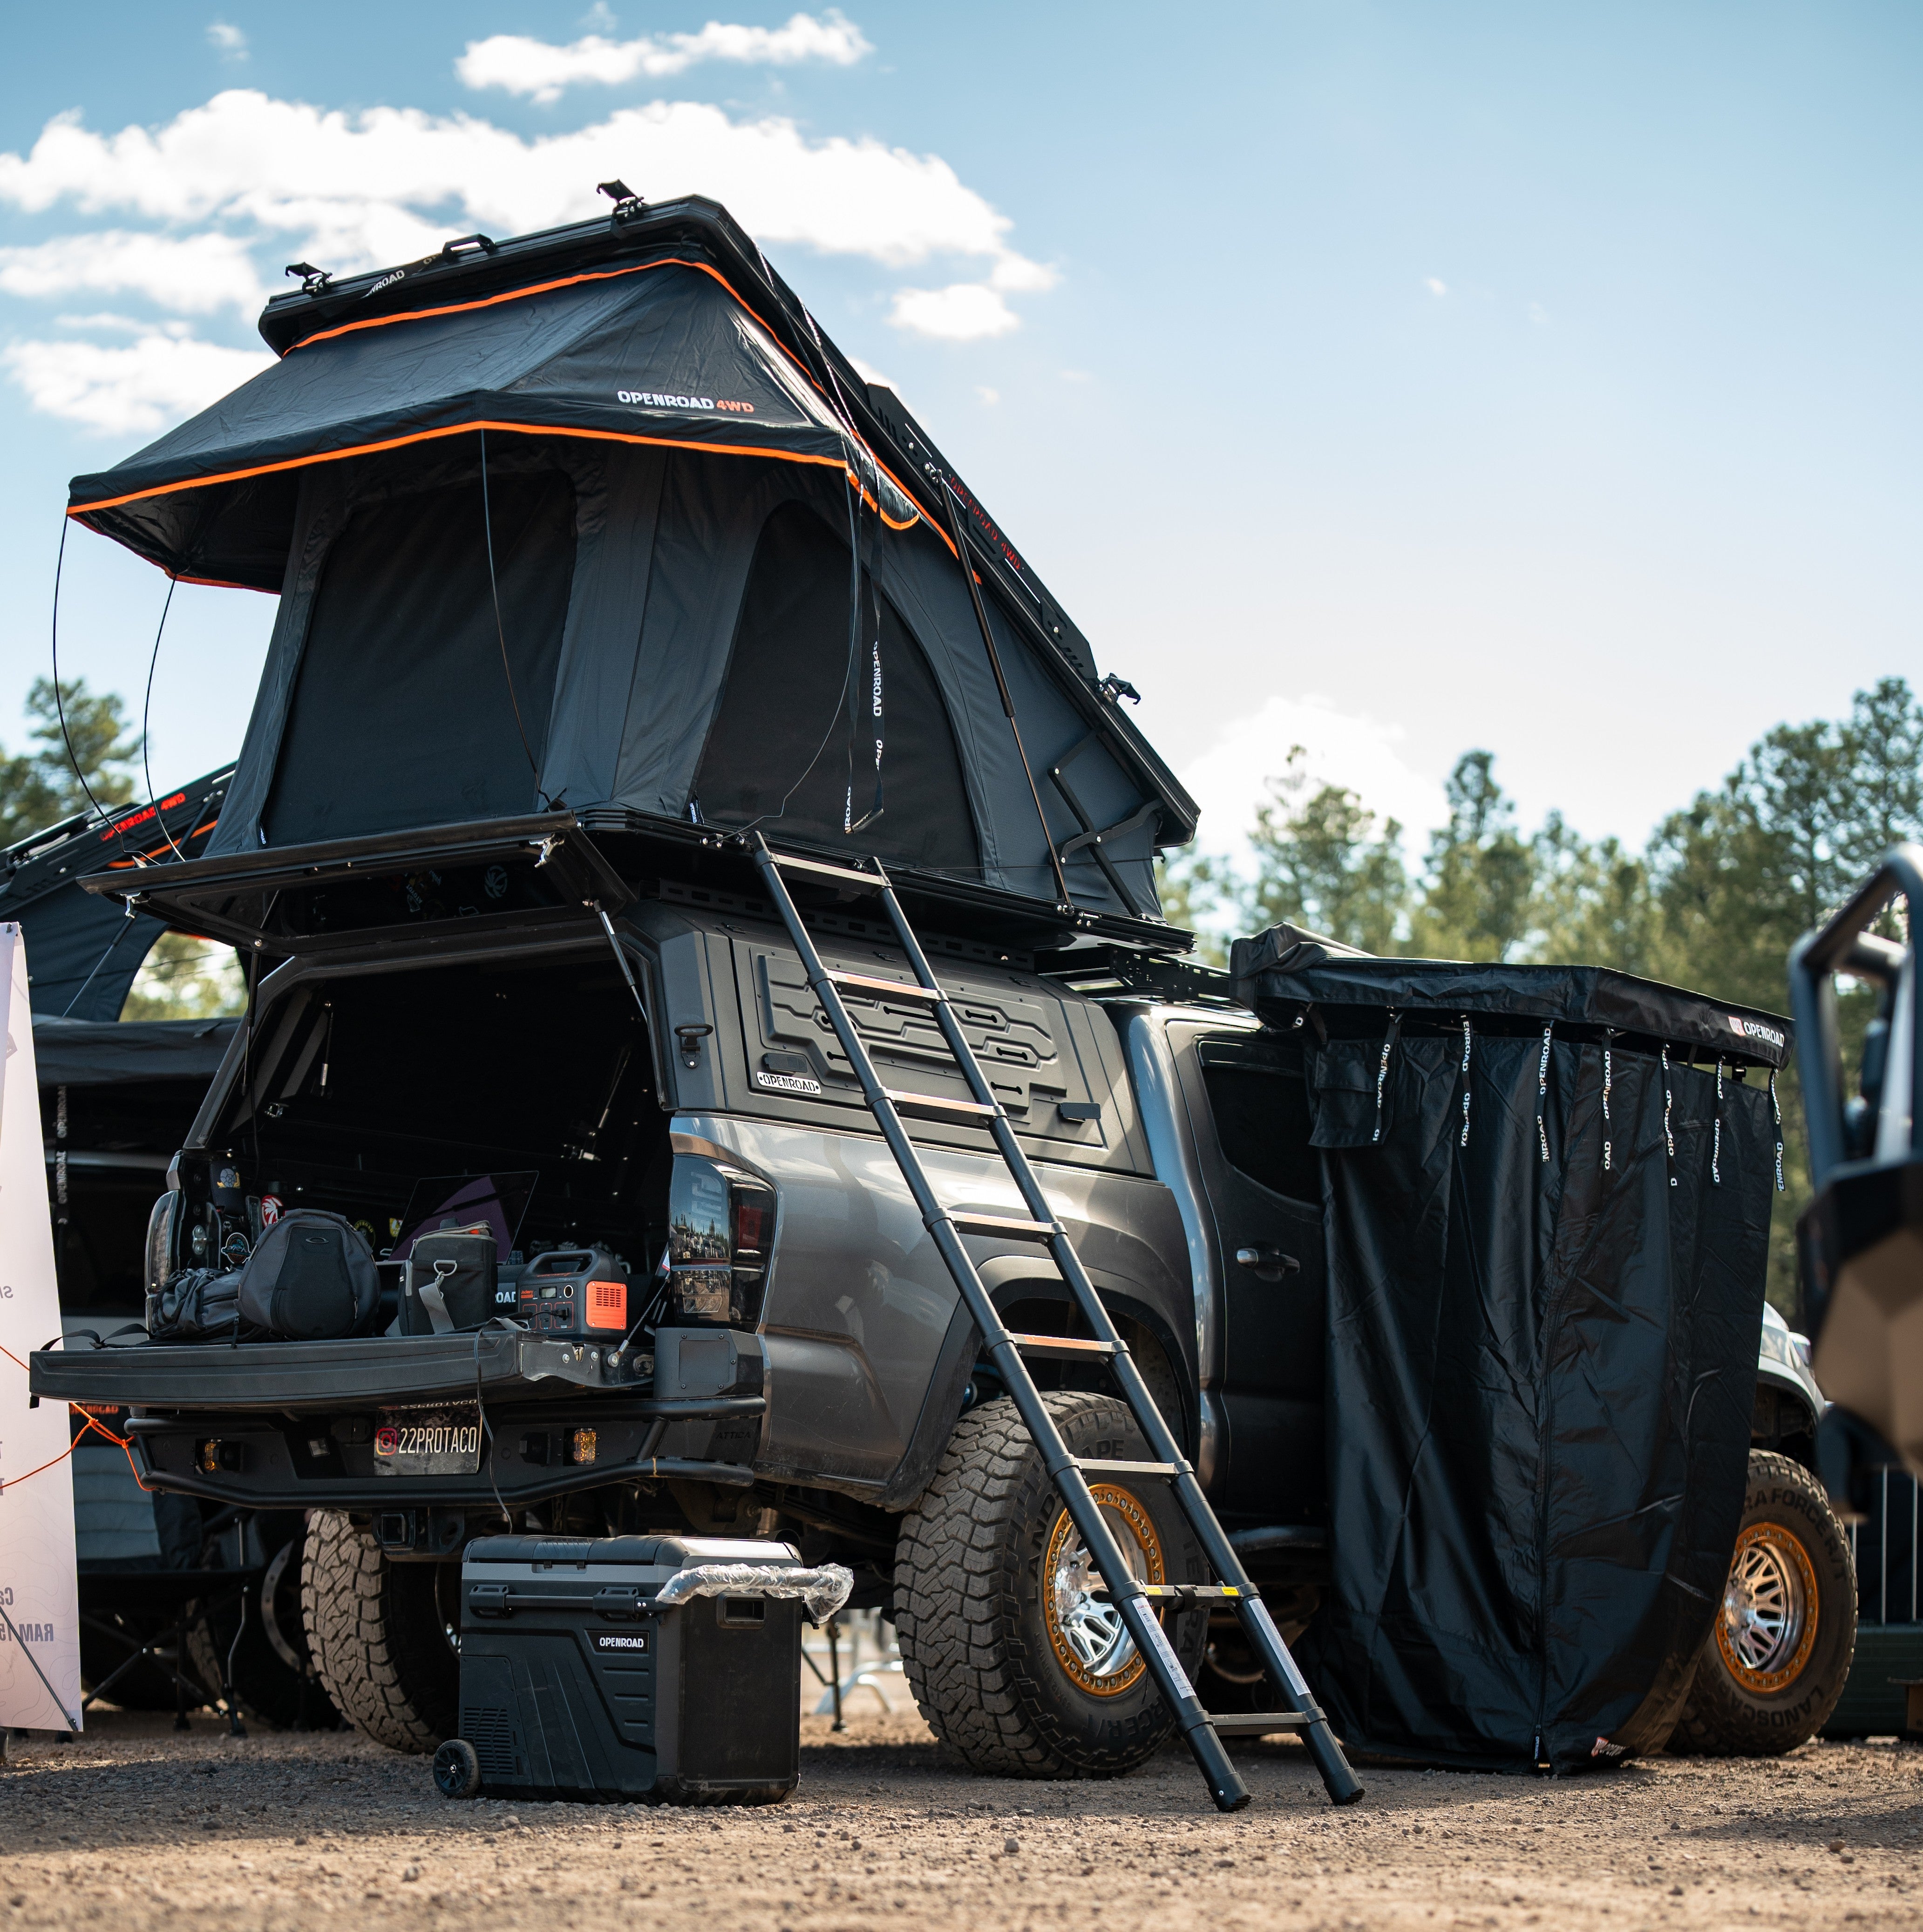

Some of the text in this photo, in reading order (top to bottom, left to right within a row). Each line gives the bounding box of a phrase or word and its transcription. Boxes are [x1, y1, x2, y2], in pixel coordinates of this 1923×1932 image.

[617, 390, 754, 413] OPENROAD 4WD
[950, 477, 1022, 570] OPENROAD 4WD
[873, 641, 882, 717] OPENROAD
[1539, 1027, 1551, 1095] OPENROAD
[1743, 1021, 1785, 1048] OPENROAD
[762, 1074, 816, 1091] OPENROAD
[1377, 1043, 1391, 1109] OPENROAD
[1603, 1051, 1611, 1119] OPENROAD
[1664, 1090, 1674, 1156] OPENROAD
[1712, 1118, 1720, 1183] OPENROAD
[398, 1426, 477, 1454] 22PROTACO
[599, 1637, 644, 1647] OPENROAD
